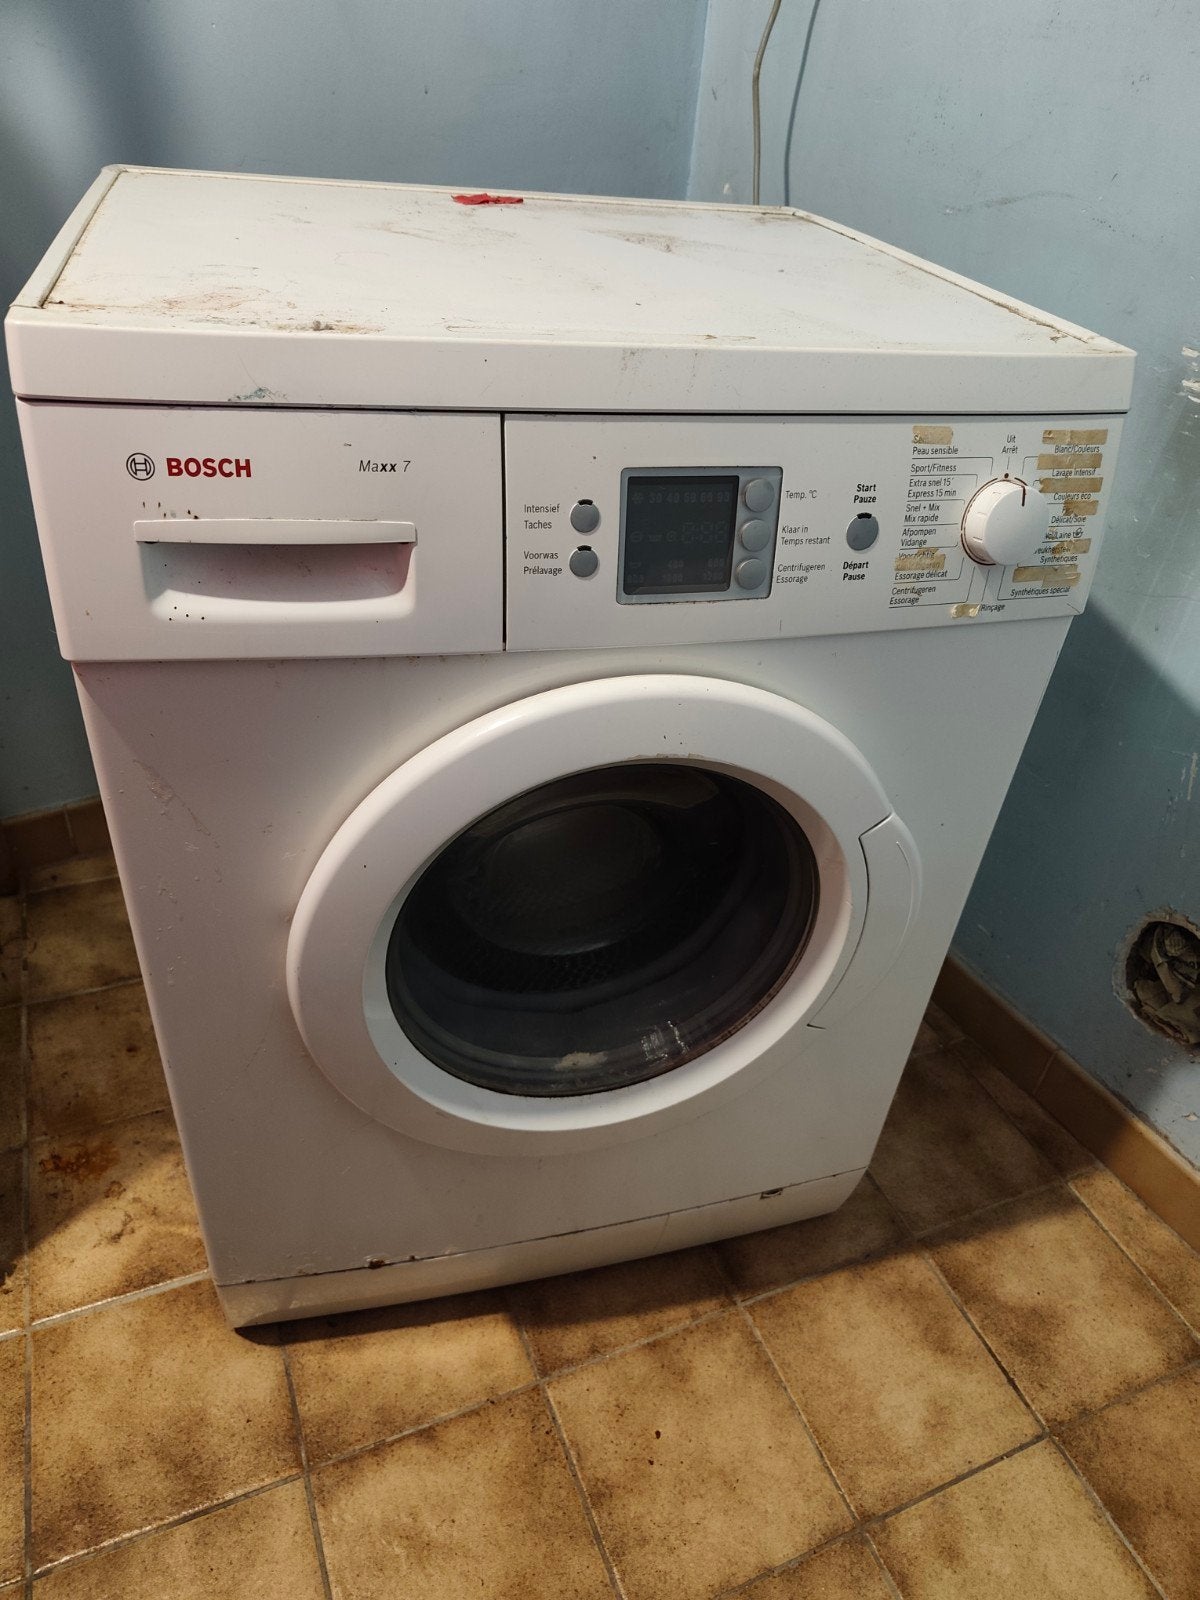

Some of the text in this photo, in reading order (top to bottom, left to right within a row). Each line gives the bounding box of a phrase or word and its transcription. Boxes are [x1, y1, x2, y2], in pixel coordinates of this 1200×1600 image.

[1006, 434, 1016, 443] Uit
[912, 446, 959, 455] Peau sensible
[1001, 445, 1018, 454] Arrêt
[1054, 444, 1100, 454] Blanc/Couleurs
[166, 457, 251, 477] BOSCH
[359, 460, 411, 472] Maxx 7
[911, 463, 957, 473] Sport/Fitness
[1051, 467, 1096, 478] Lavage intensif
[909, 478, 926, 487] Extra
[928, 477, 942, 486] snel
[857, 483, 877, 493] Start
[785, 490, 807, 500] Temp.
[907, 489, 934, 499] Express
[935, 489, 943, 497] 15
[1053, 492, 1079, 501] Couleurs
[853, 495, 877, 504] Pauze
[524, 504, 560, 513] Intensief
[906, 503, 920, 512] Snel
[929, 503, 940, 511] Mix
[904, 513, 939, 523] Mix rapide
[1051, 516, 1086, 524] Délicat/Soie
[524, 520, 552, 529] Taches
[781, 525, 809, 534] Klaar in
[902, 527, 937, 537] Afpompen
[781, 536, 831, 547] Temps restant
[901, 538, 927, 547] Vidange
[523, 551, 559, 560] Voorwas
[777, 562, 826, 573] Centrifugeren
[843, 561, 869, 571] Départ
[523, 566, 563, 577] Prélavage
[895, 570, 948, 581] Essorage délicat
[776, 575, 808, 584] Essorage
[843, 572, 866, 582] Pause
[891, 586, 936, 597] Centrifugeren
[1010, 585, 1070, 598] Synthétiques spécial
[889, 597, 920, 606] Essorage
[980, 603, 1005, 613] Rinçage
